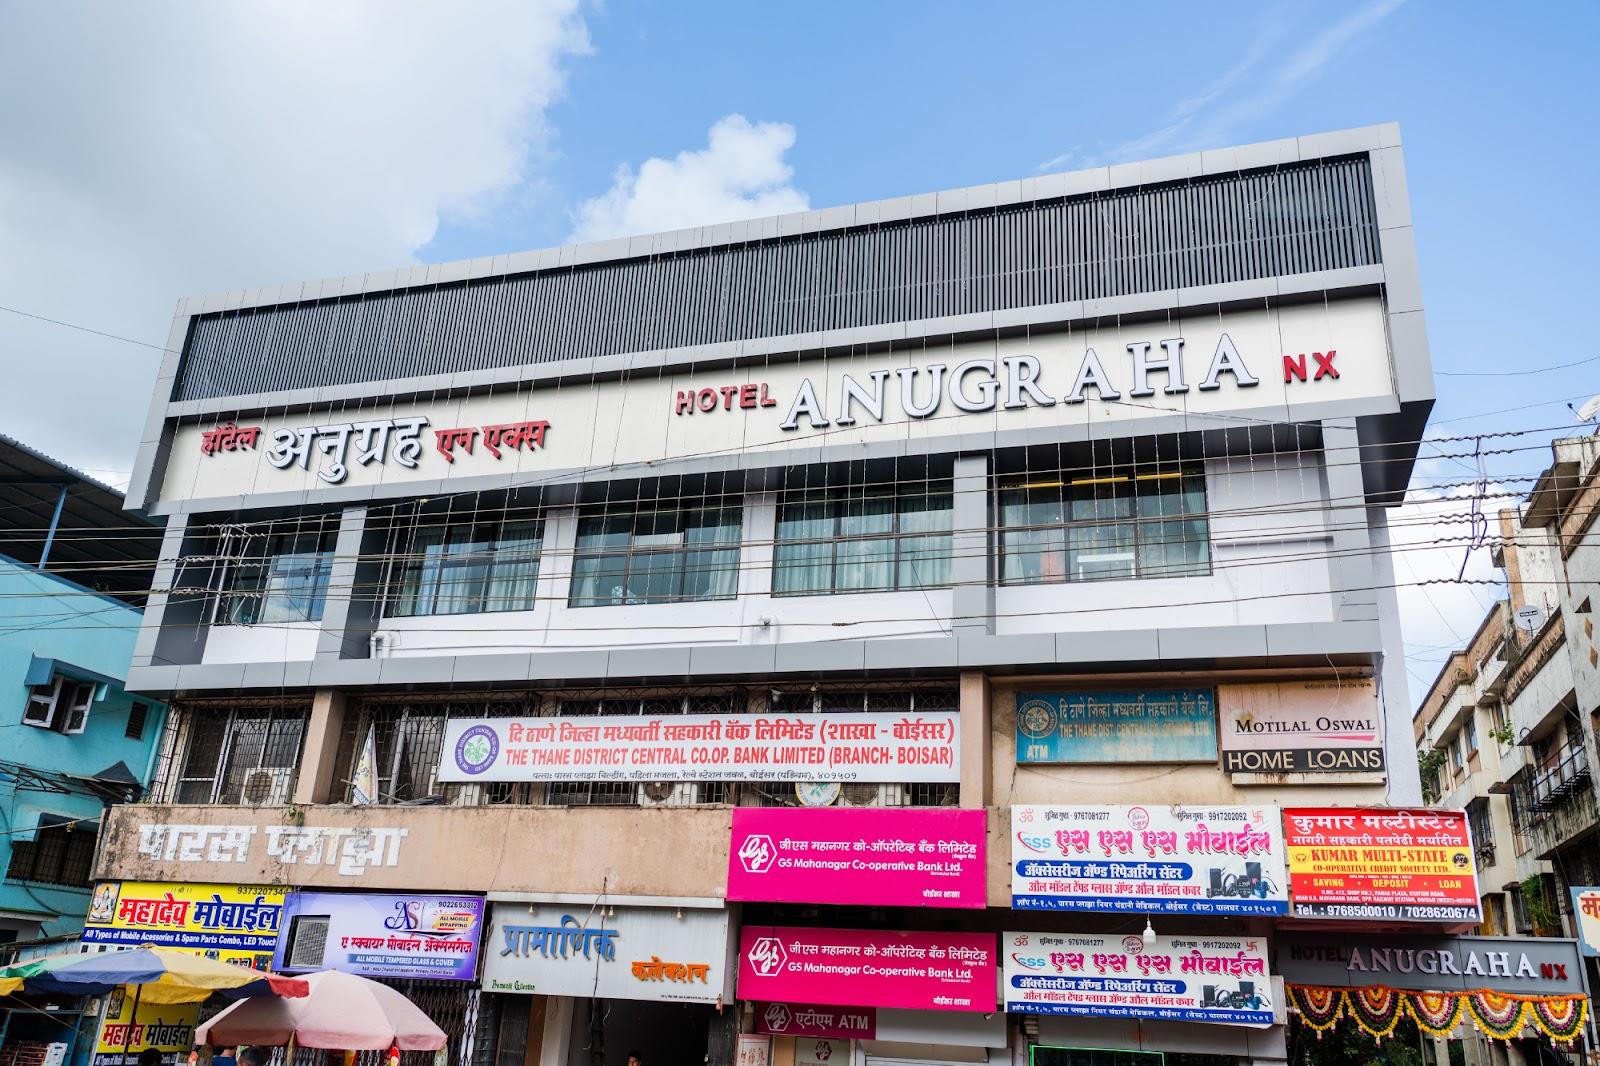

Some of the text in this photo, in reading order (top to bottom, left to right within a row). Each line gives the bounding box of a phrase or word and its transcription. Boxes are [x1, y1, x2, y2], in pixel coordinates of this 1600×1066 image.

[676, 332, 1341, 429] HOTEL ANUGRAHA NX
[265, 416, 430, 482] अनुग्रह
[435, 425, 481, 464] एन
[482, 420, 551, 460] एक्स
[508, 723, 524, 743] दि
[526, 722, 556, 743] ठाणे
[559, 720, 602, 743] जिल्हा
[603, 720, 662, 742] मध्यवर्ती
[663, 719, 722, 740] सहकारी
[755, 718, 817, 740] लिमिटेड
[819, 719, 877, 744] (शाखा
[893, 718, 955, 744] बोईसर)
[505, 748, 528, 765] THE
[531, 748, 573, 765] THANE
[574, 748, 627, 764] DISTRICT
[631, 748, 686, 764] CENTRAL
[734, 747, 769, 764] BANK
[773, 747, 825, 764] LIMITED
[897, 747, 953, 768] BOISAR)
[1026, 745, 1048, 759] ATM
[1228, 749, 1382, 770] HOME LOANS
[1291, 811, 1460, 834] कुमार मल्टीस्टेट
[138, 824, 258, 862] पारस
[811, 841, 851, 852] महानगर
[938, 839, 977, 855] लिमिटेड
[1056, 823, 1271, 860] एस एस एस मोबाईल
[1292, 832, 1462, 847] नागरी सहकारी पतपेढी मर्यादीत
[1311, 849, 1448, 863] KUMAR MULTI-STATE
[777, 860, 963, 873] GS Mahanagar Co-operative Bank Ltd.
[1160, 865, 1184, 879] सेंटर
[1313, 865, 1368, 873] CO-OPERATIVE
[1370, 865, 1398, 873] CREDIT
[1399, 865, 1432, 873] SOCIETY
[1313, 878, 1462, 889] SAVING DEPOSIT LOAN
[118, 893, 283, 932] महादेव मोबाईल
[1296, 904, 1476, 919] Tel. 9768500010 7028620674
[95, 931, 112, 941] Types
[121, 932, 140, 940] Mobile
[141, 933, 174, 942] Acessories
[175, 934, 180, 942] &
[181, 934, 200, 944] Spare
[201, 935, 218, 944] Parts
[218, 936, 242, 946] Combo,
[243, 936, 257, 945] LED
[500, 914, 620, 962] प्रामाणिक
[385, 957, 412, 965] TEMPERED
[435, 959, 455, 967] COVER
[821, 945, 861, 957] महानगर
[947, 946, 988, 961] लिमिटेड
[787, 963, 974, 979] GS Mahanagar Co-operative Bank Ltd.
[1049, 949, 1265, 980] एस एस एस मोबाईल
[1291, 945, 1568, 980] HOTEL ANUGRAHA NX
[1153, 980, 1176, 993] सेंटर
[795, 1009, 868, 1030] एटीएम ATM
[145, 1018, 193, 1047] मोबाईल
